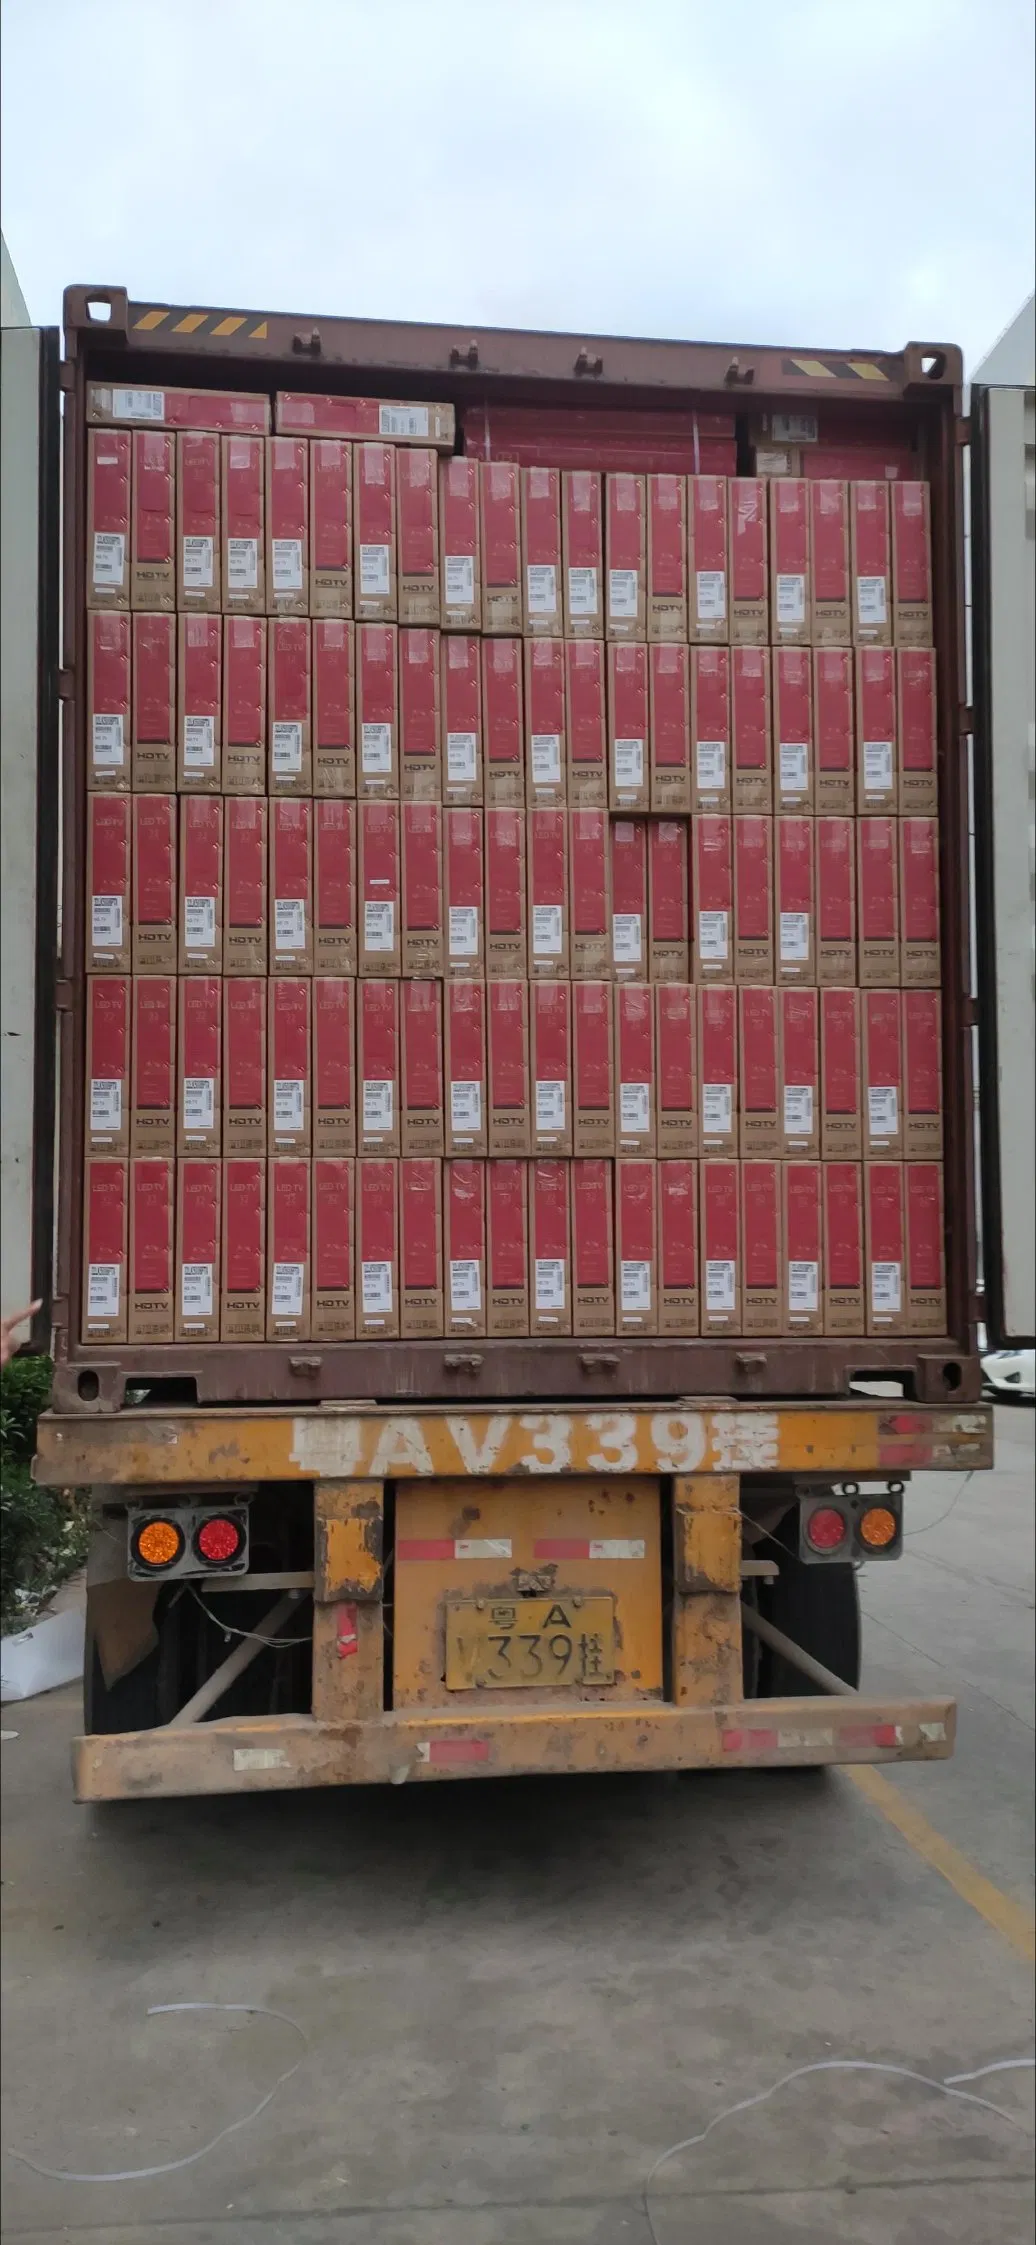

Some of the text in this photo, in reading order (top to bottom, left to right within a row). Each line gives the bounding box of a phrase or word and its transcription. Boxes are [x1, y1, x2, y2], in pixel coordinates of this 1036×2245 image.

[319, 937, 350, 945] HDTV
[738, 948, 768, 956] HDTV
[746, 1120, 776, 1128] HDTV
[578, 1296, 609, 1304] HDTV
[542, 1604, 572, 1629] A
